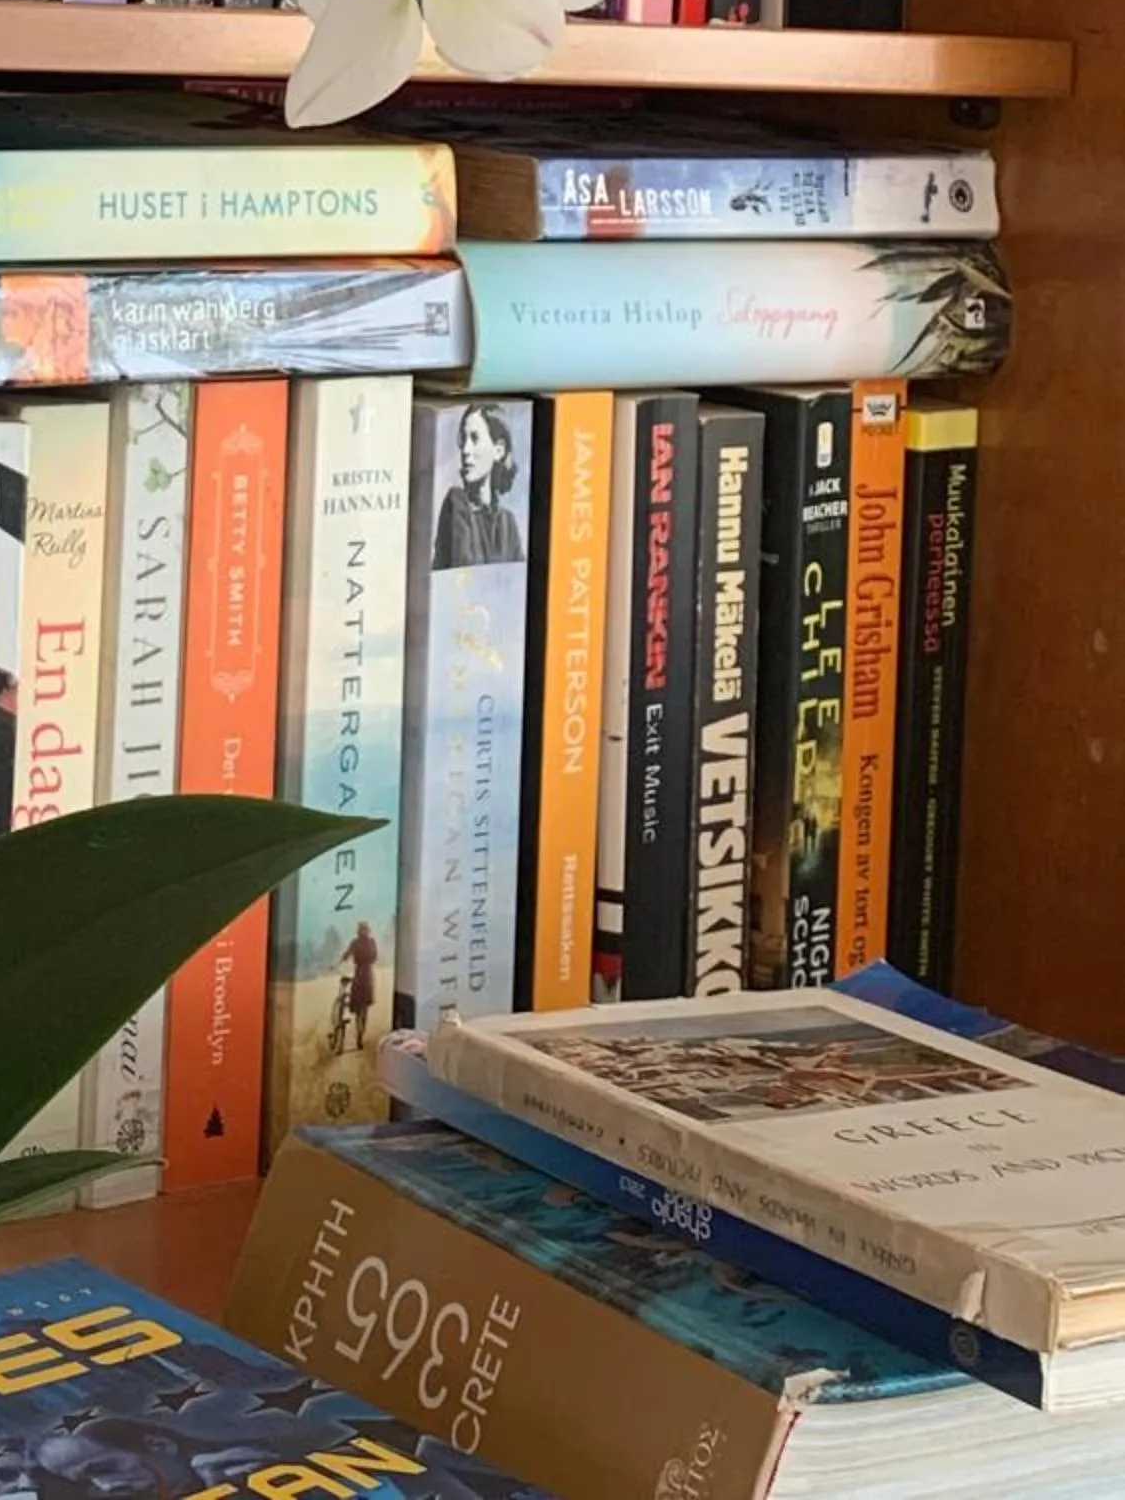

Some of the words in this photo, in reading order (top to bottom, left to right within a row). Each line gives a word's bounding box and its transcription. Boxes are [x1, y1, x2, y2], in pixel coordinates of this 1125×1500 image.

[99, 191, 188, 220] HUSET
[219, 188, 379, 218] HAMPTONS
[563, 168, 609, 204] ÅSA
[619, 182, 715, 217] LARSSON
[510, 301, 613, 326] Victoria
[623, 300, 704, 330] Hislop
[322, 493, 401, 516] HANNAH
[331, 469, 394, 487] KRISTIN
[569, 427, 595, 542] JAMES
[650, 422, 674, 504] IAN
[717, 446, 749, 564] Hannu
[230, 474, 250, 555] BETTY
[855, 483, 898, 564] John
[941, 464, 967, 627] Muukalainen
[130, 516, 171, 708] SARAH
[227, 565, 245, 647] SMITH
[644, 511, 671, 690] RANKIN
[712, 569, 747, 703] Mäkelä
[33, 618, 87, 706] En
[562, 558, 592, 774] PATTERSON
[818, 598, 844, 728] LEE
[851, 575, 896, 720] Grisham
[222, 737, 243, 781] Det
[333, 539, 367, 913] NATTERGAEN
[473, 693, 496, 804] CURTIS
[644, 703, 663, 755] Exit
[641, 765, 661, 844] Music
[854, 754, 880, 846] Kongen
[467, 814, 491, 993] SITTENFELD
[857, 854, 872, 881] av
[558, 852, 578, 981] Rettssaken
[848, 936, 869, 968] og
[209, 956, 234, 1066] Brooklyn
[834, 1107, 1037, 1145] GREECE
[851, 1169, 980, 1193] WORDS
[991, 1157, 1062, 1178] AND
[333, 1254, 471, 1411] 365
[450, 1293, 522, 1456] CRETE
